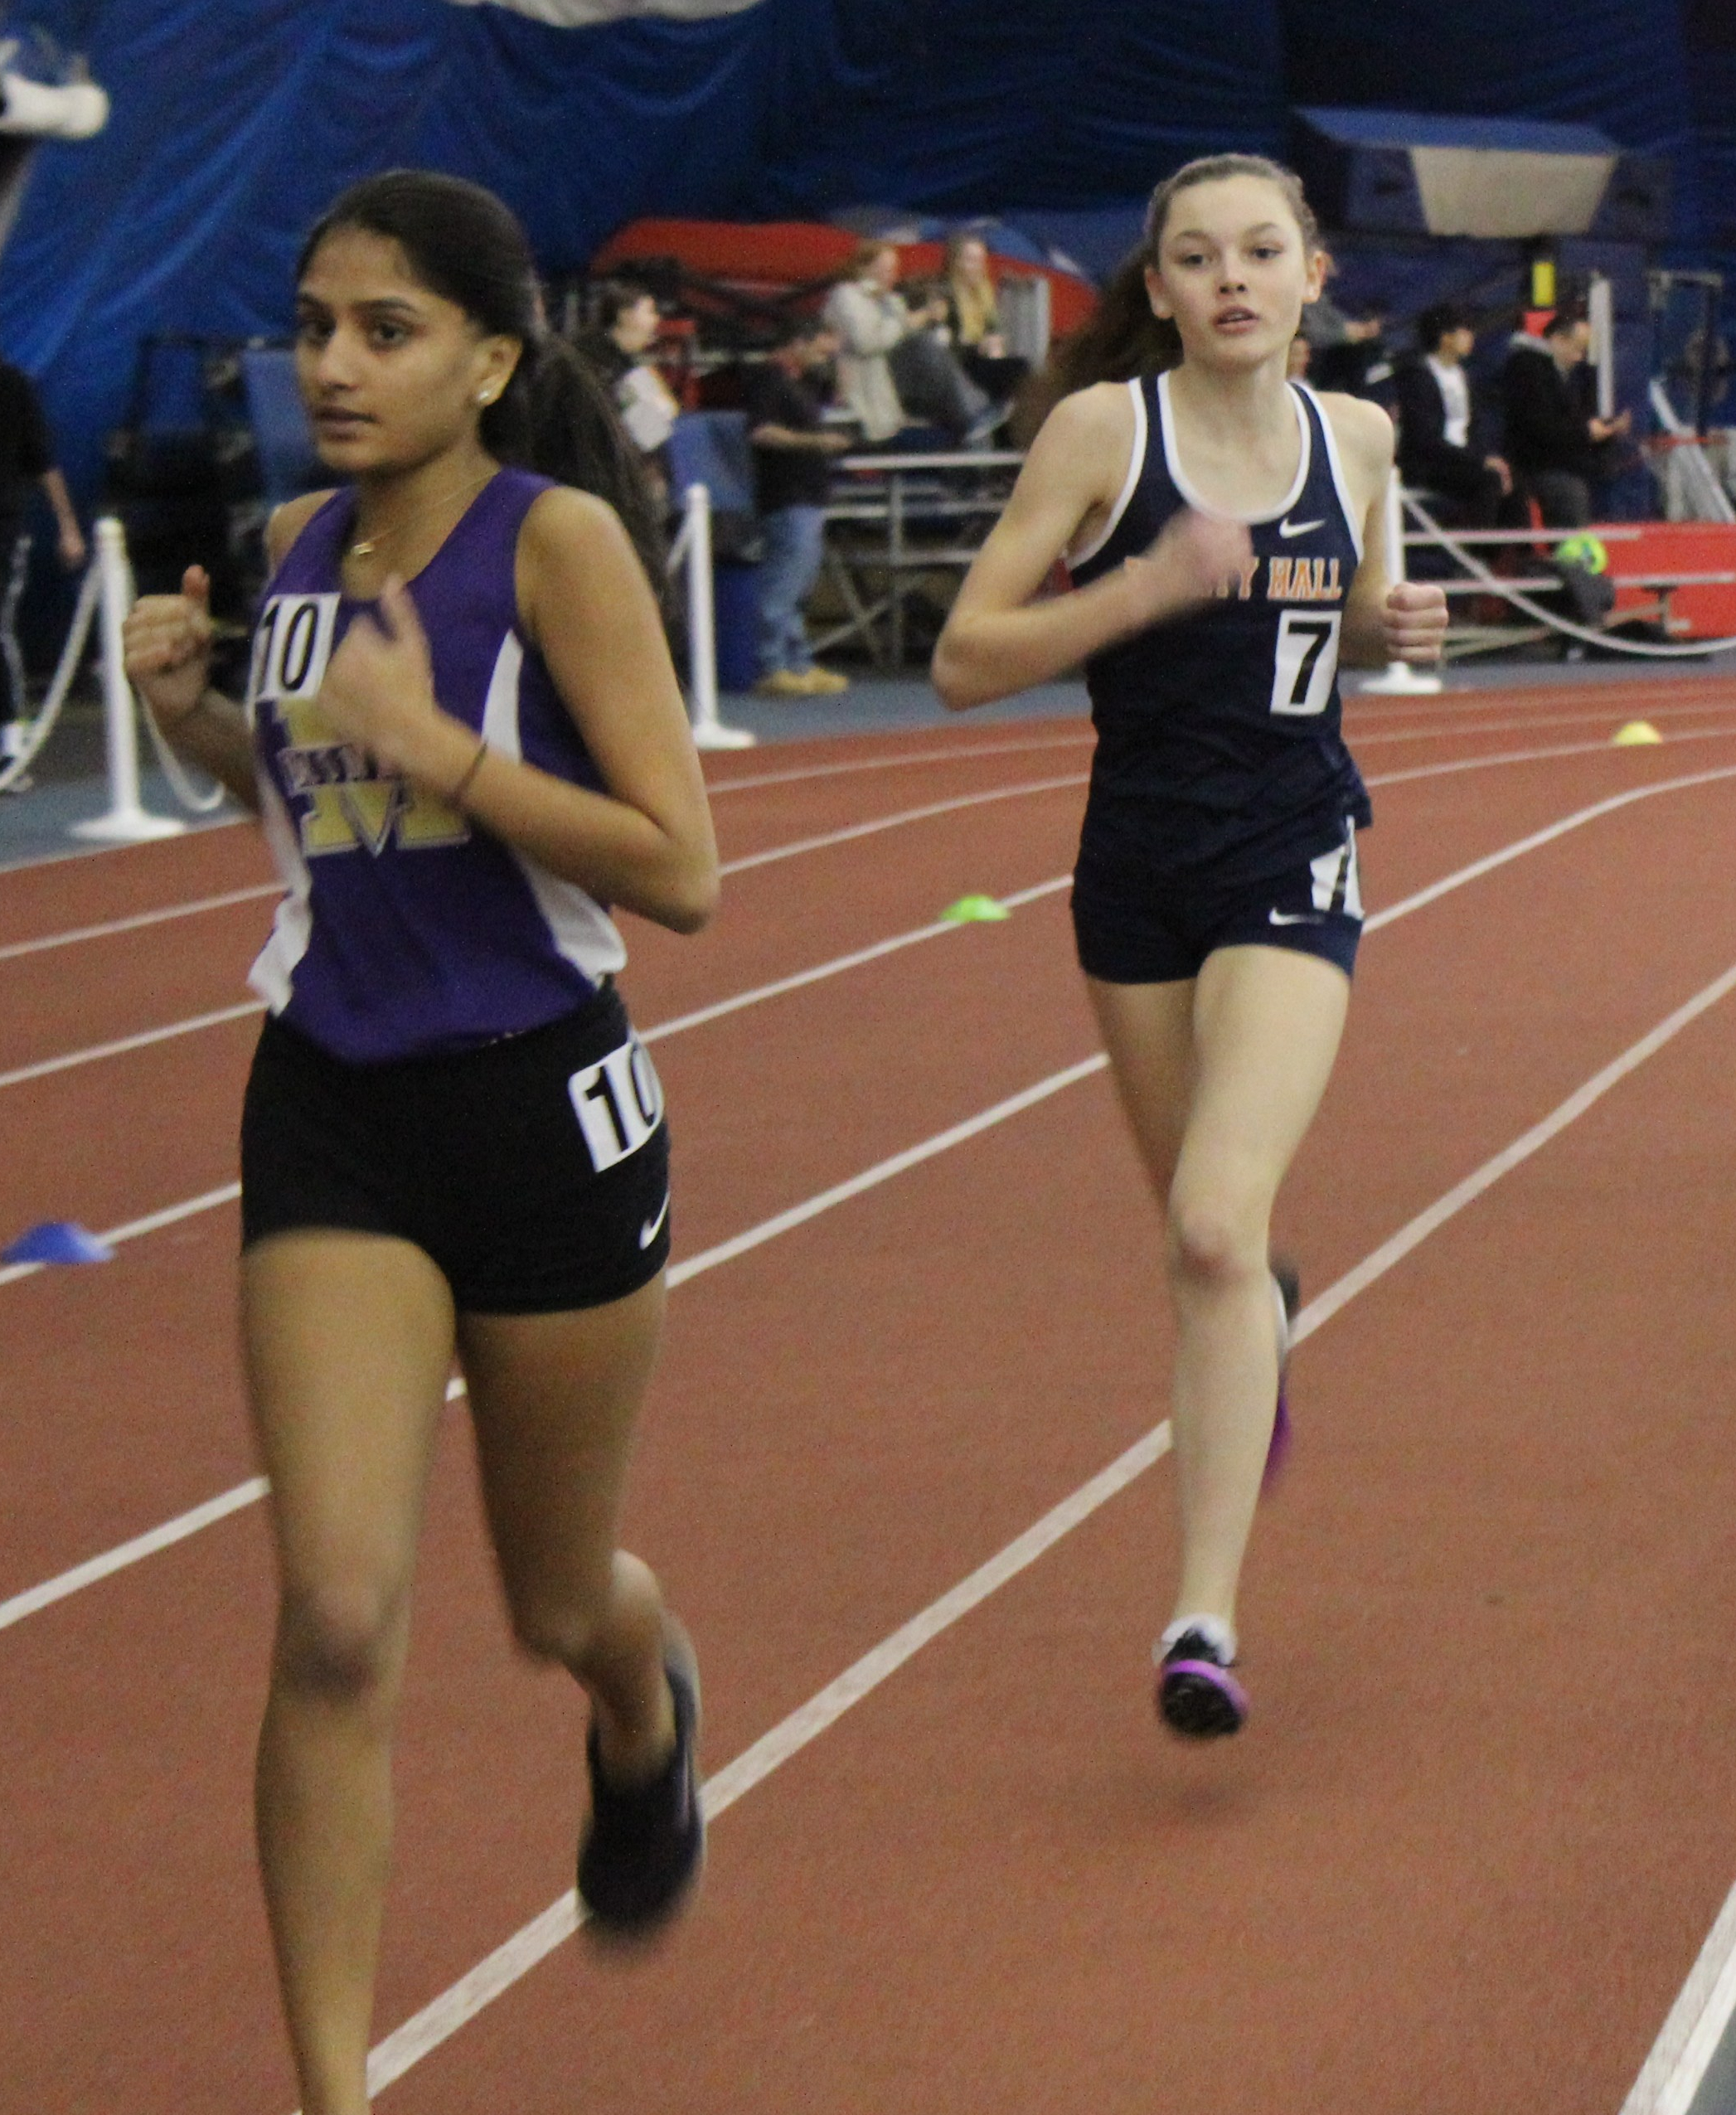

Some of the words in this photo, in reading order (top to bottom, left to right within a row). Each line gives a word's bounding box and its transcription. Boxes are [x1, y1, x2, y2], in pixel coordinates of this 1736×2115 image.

[1267, 556, 1343, 601] HALL
[255, 602, 320, 695] 10
[1287, 621, 1333, 706] 7
